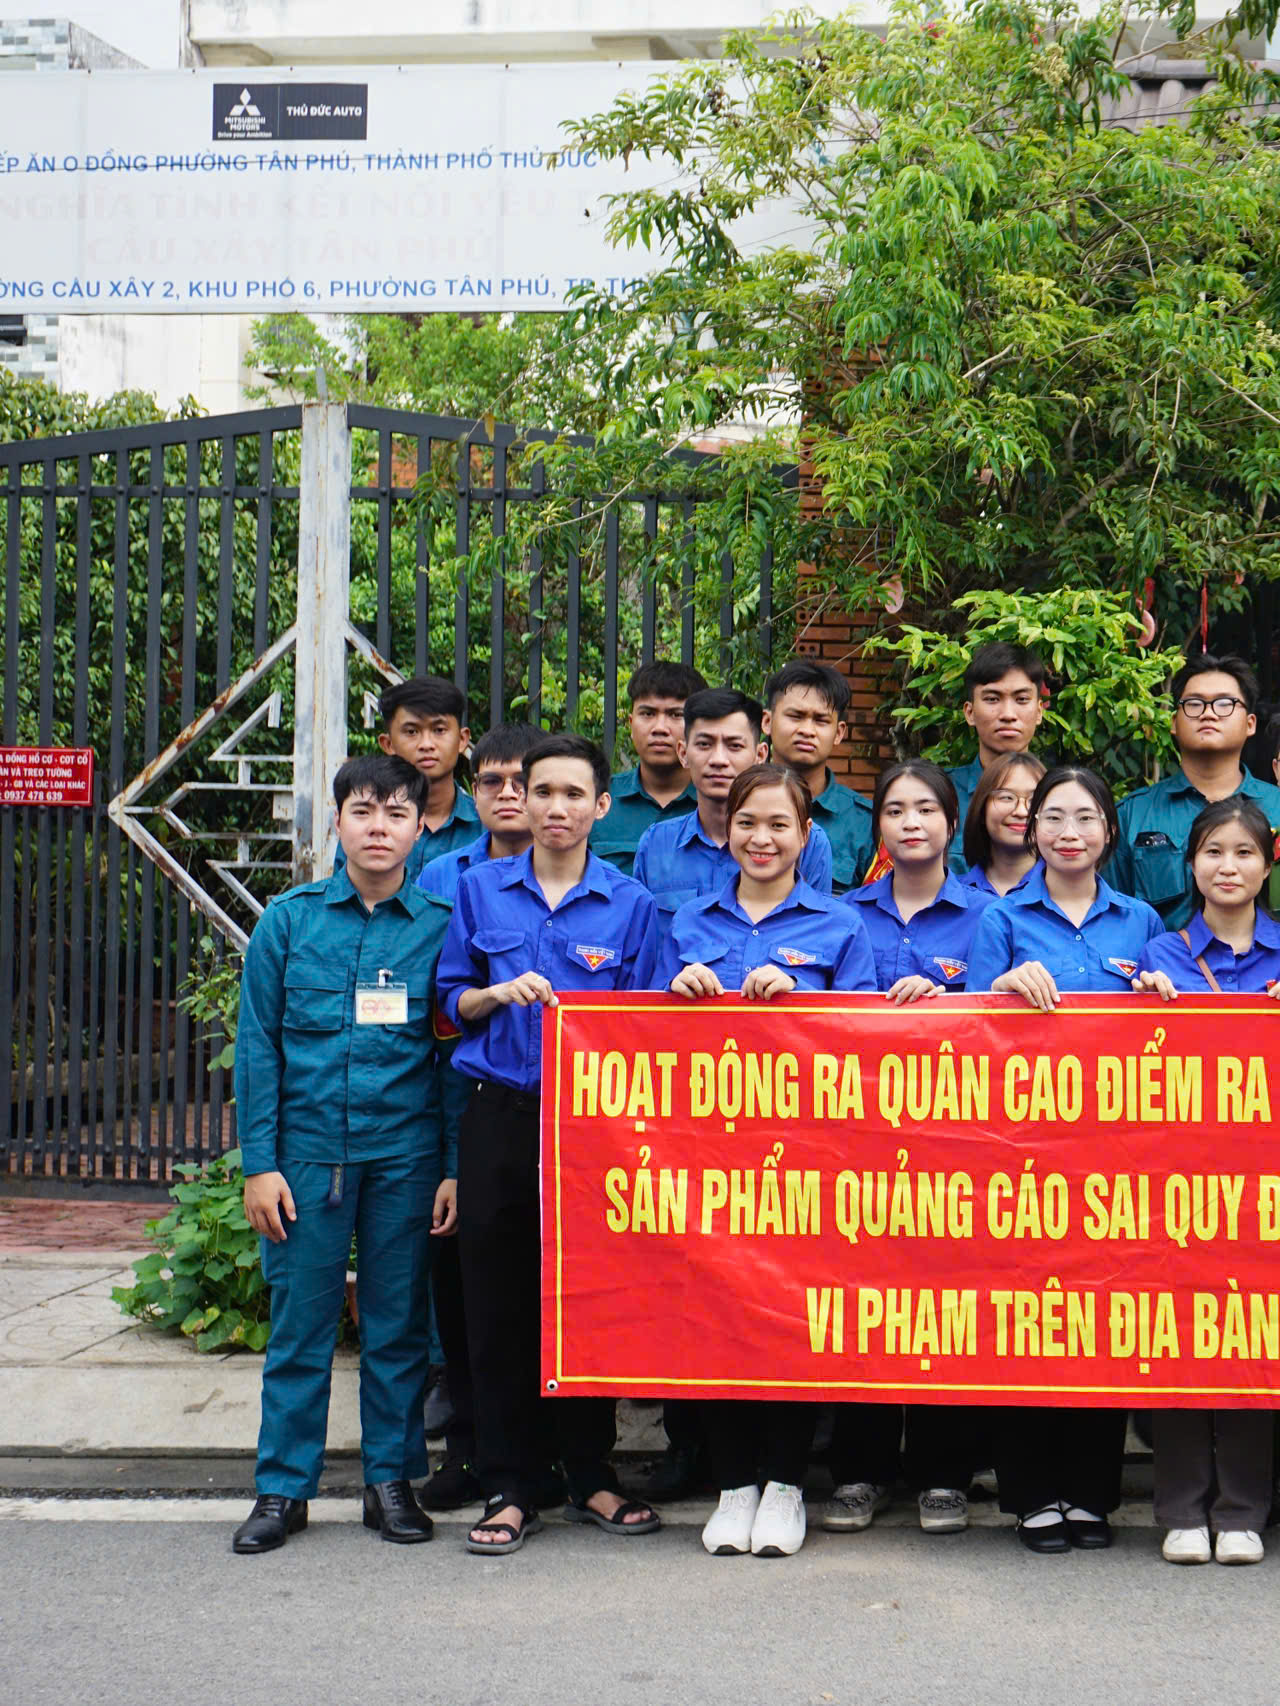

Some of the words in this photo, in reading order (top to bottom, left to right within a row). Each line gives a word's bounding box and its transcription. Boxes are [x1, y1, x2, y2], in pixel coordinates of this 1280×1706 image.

[224, 116, 266, 124] MITSUBISHI
[286, 103, 308, 117] THỦ
[310, 103, 332, 117] ĐỨC
[333, 105, 363, 117] AUTO
[230, 123, 260, 131] MOTORS
[85, 148, 149, 172] ĐỒNG
[155, 148, 248, 172] PHƯỜNG
[255, 150, 297, 171] TÂN
[306, 149, 356, 174] PHÚ,
[364, 148, 438, 171] THÀNH
[446, 144, 494, 169] PHỐ
[109, 276, 155, 298] XÂY
[162, 281, 180, 300] 2,
[189, 280, 237, 298] KHU
[303, 280, 321, 300] 6,
[330, 275, 437, 298] PHƯỜNG
[444, 274, 492, 296] TÂN
[501, 273, 557, 298] PHÚ,
[24, 768, 44, 777] TREO
[572, 1051, 678, 1133] HOẠT
[689, 1038, 800, 1133] ĐỘNG
[813, 1053, 865, 1120] RA
[878, 1039, 990, 1129] QUÂN
[1003, 1054, 1083, 1123] CAO
[1095, 1027, 1203, 1122] ĐIỂM
[1217, 1055, 1272, 1123] RA
[605, 1145, 689, 1234] SẢN
[700, 1141, 821, 1235] PHẨM
[835, 1148, 974, 1244] QUẢNG
[987, 1158, 1069, 1240] CÁO
[1083, 1172, 1150, 1241] SAI
[1164, 1173, 1245, 1249] QUY
[806, 1287, 844, 1354] VI
[857, 1287, 977, 1371] PHẠM
[990, 1276, 1097, 1357] TRÊN
[1108, 1292, 1180, 1374] ĐỊA
[1193, 1278, 1280, 1360] BÀN
